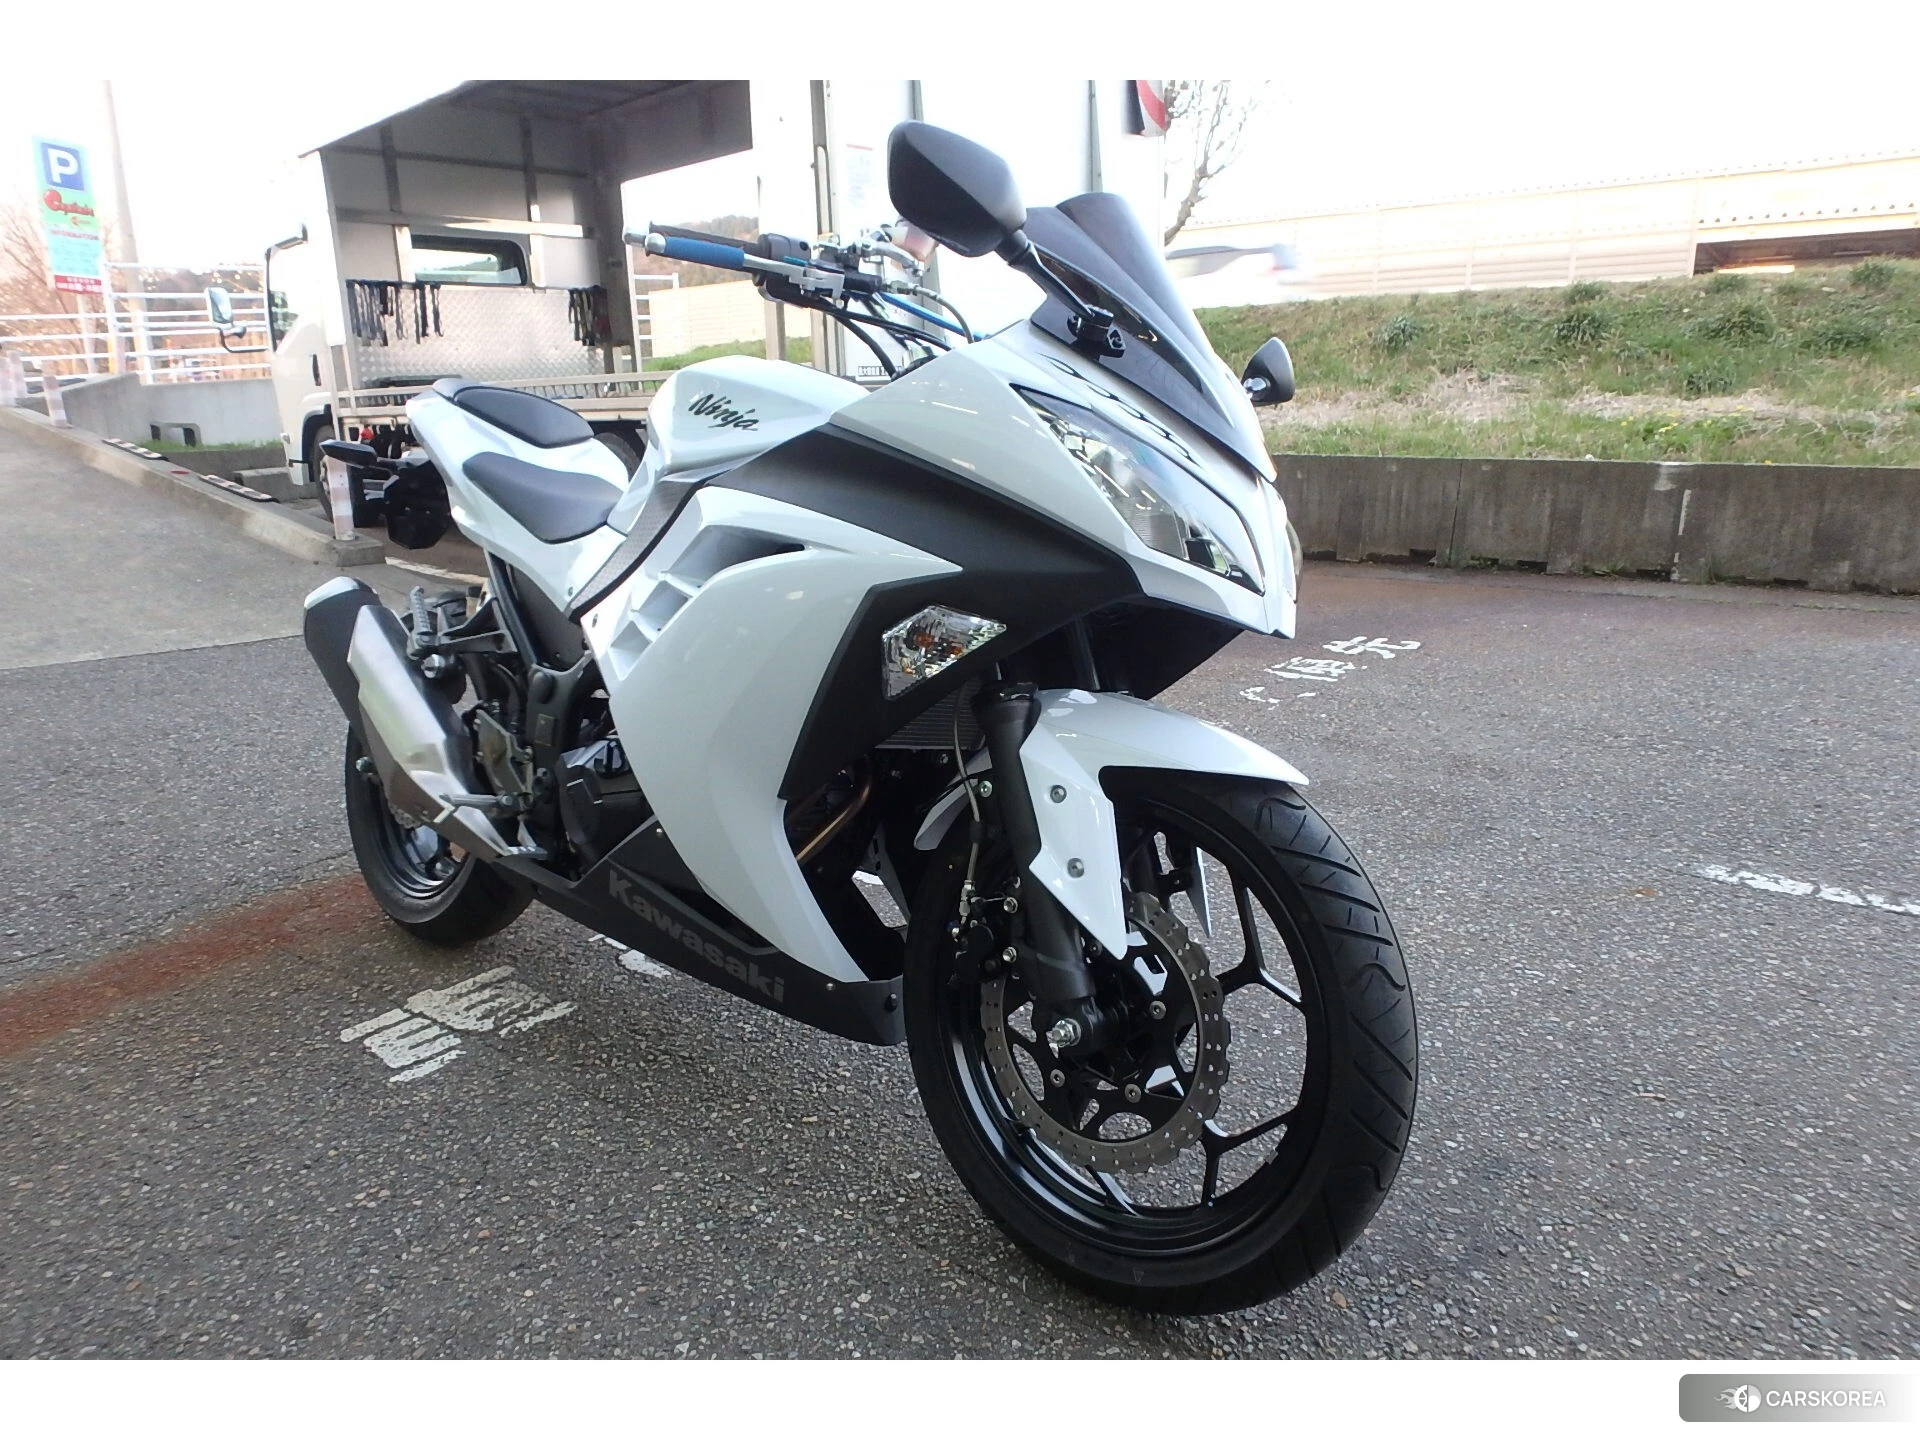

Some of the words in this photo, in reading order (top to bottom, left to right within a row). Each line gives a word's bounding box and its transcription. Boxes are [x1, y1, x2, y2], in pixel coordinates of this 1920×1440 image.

[47, 148, 79, 183] P
[688, 393, 759, 431] Ninja
[608, 868, 785, 1003] Kawasaki
